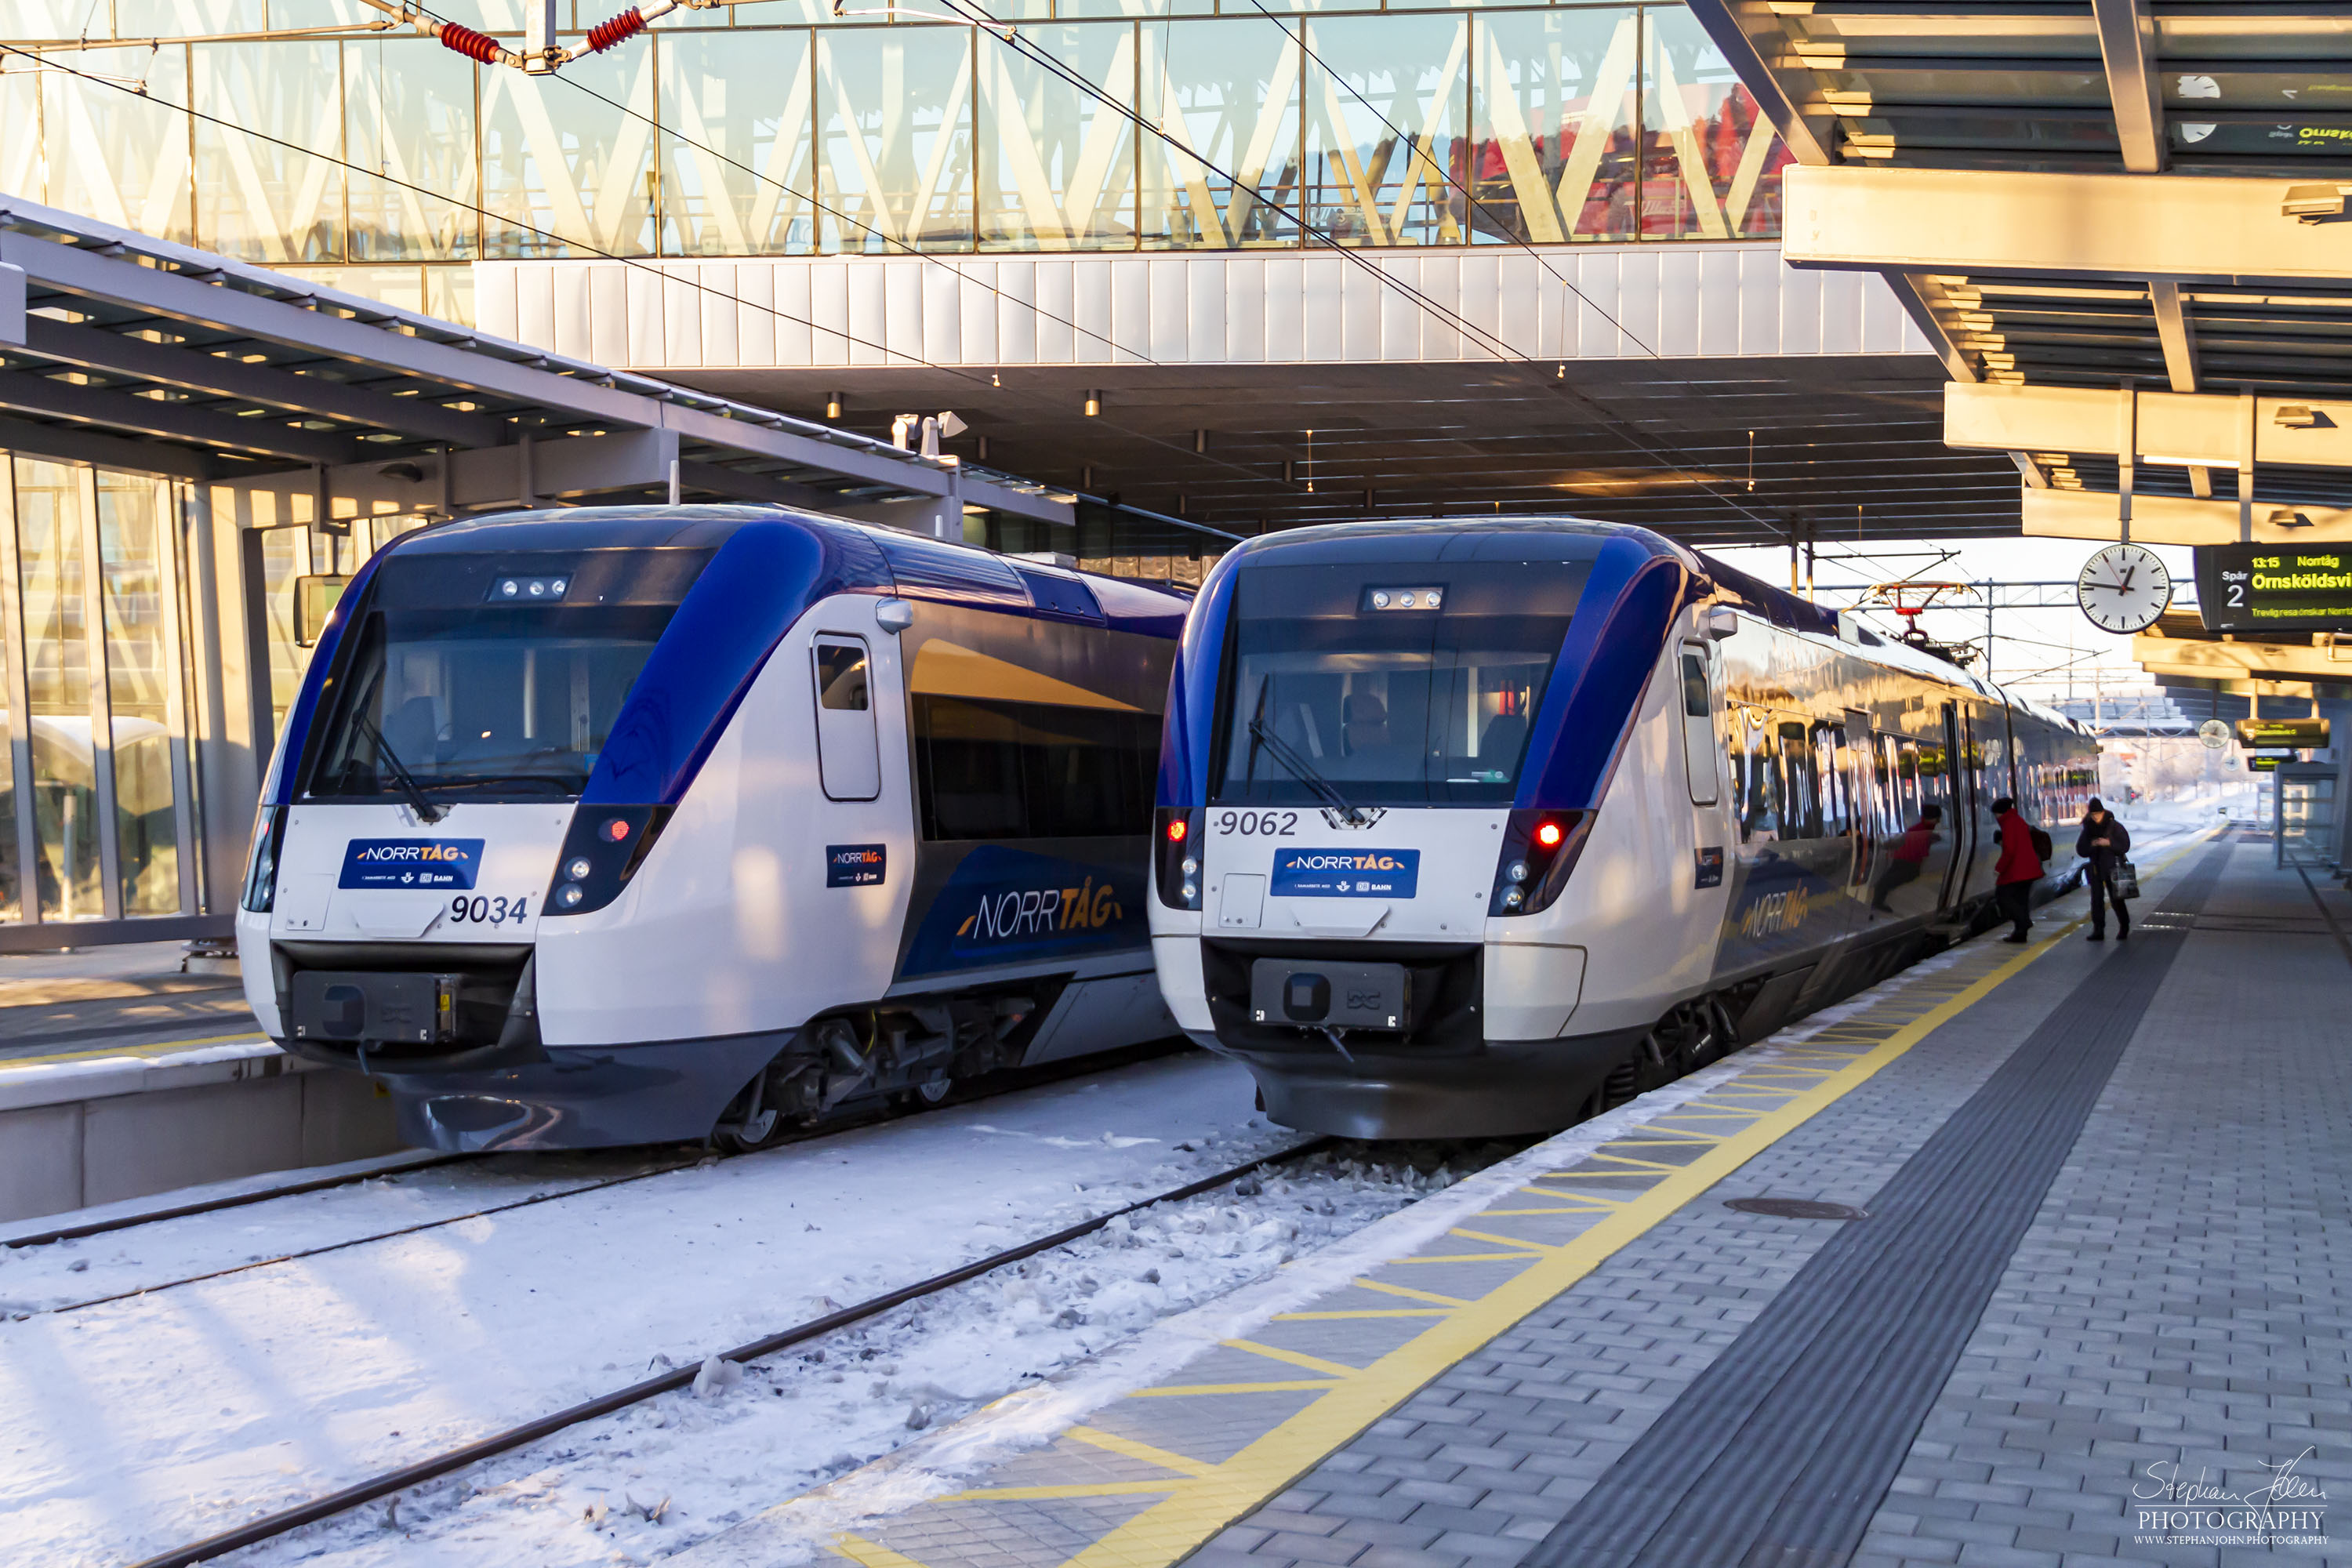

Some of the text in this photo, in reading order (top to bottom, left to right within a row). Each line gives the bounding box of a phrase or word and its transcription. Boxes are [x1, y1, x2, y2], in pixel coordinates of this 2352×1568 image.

[2252, 554, 2339, 568] 13:15 Norrtåg
[2222, 571, 2248, 581] Spår
[2227, 585, 2244, 608] 2
[1219, 811, 1298, 836] 9062
[367, 844, 459, 861] NORRTÅG
[837, 850, 878, 863] NORRTÅG
[1296, 854, 1395, 869] NORRTÅG
[1357, 882, 1369, 891] DB
[451, 895, 528, 924] 9034
[974, 876, 1114, 938] NORRTÅG
